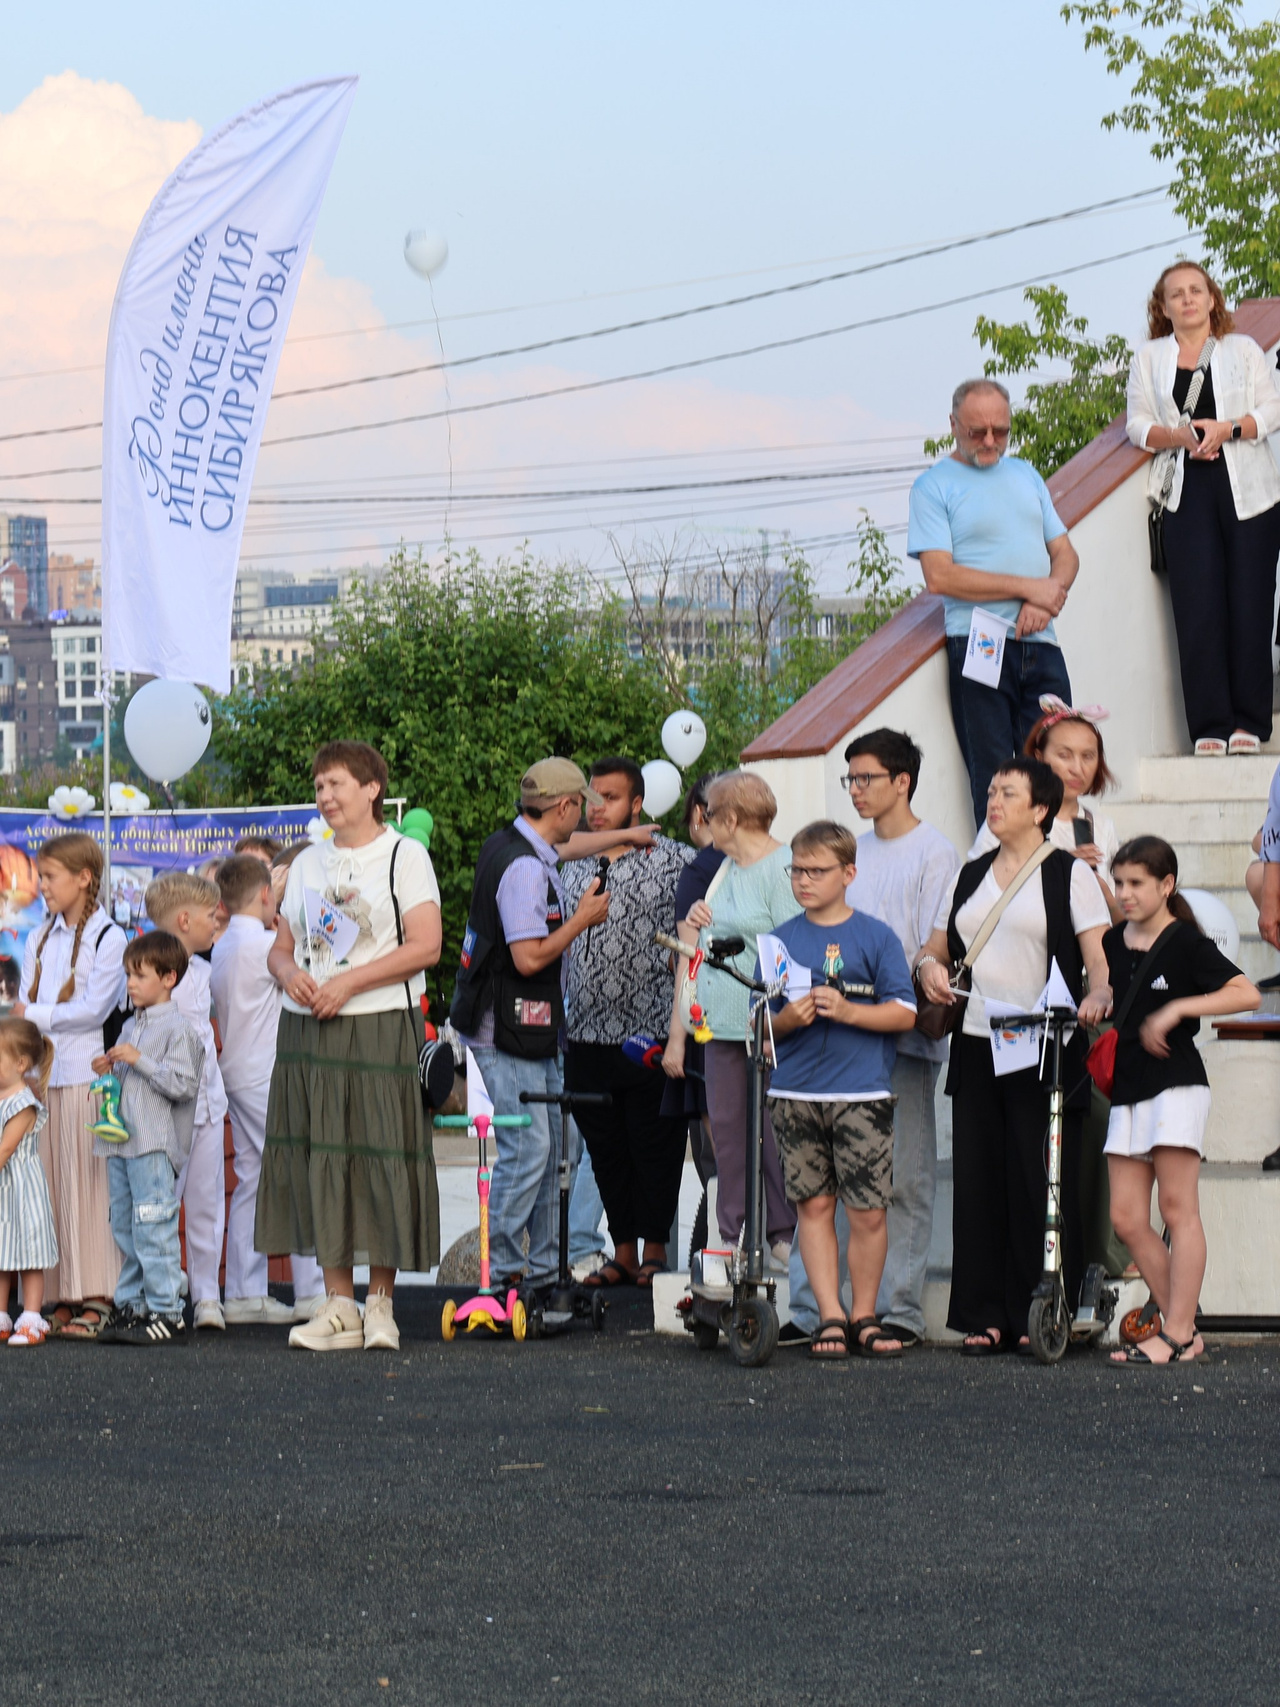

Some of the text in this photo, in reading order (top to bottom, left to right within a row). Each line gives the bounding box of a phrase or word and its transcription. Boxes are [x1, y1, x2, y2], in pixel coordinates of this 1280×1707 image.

[162, 231, 207, 353] имени
[168, 223, 259, 530] ИННОКЕНТИЯ
[199, 243, 299, 532] СИБИРЯКОВА
[120, 825, 235, 841] общественных
[134, 840, 178, 853] семей
[185, 838, 239, 855] Иркут
